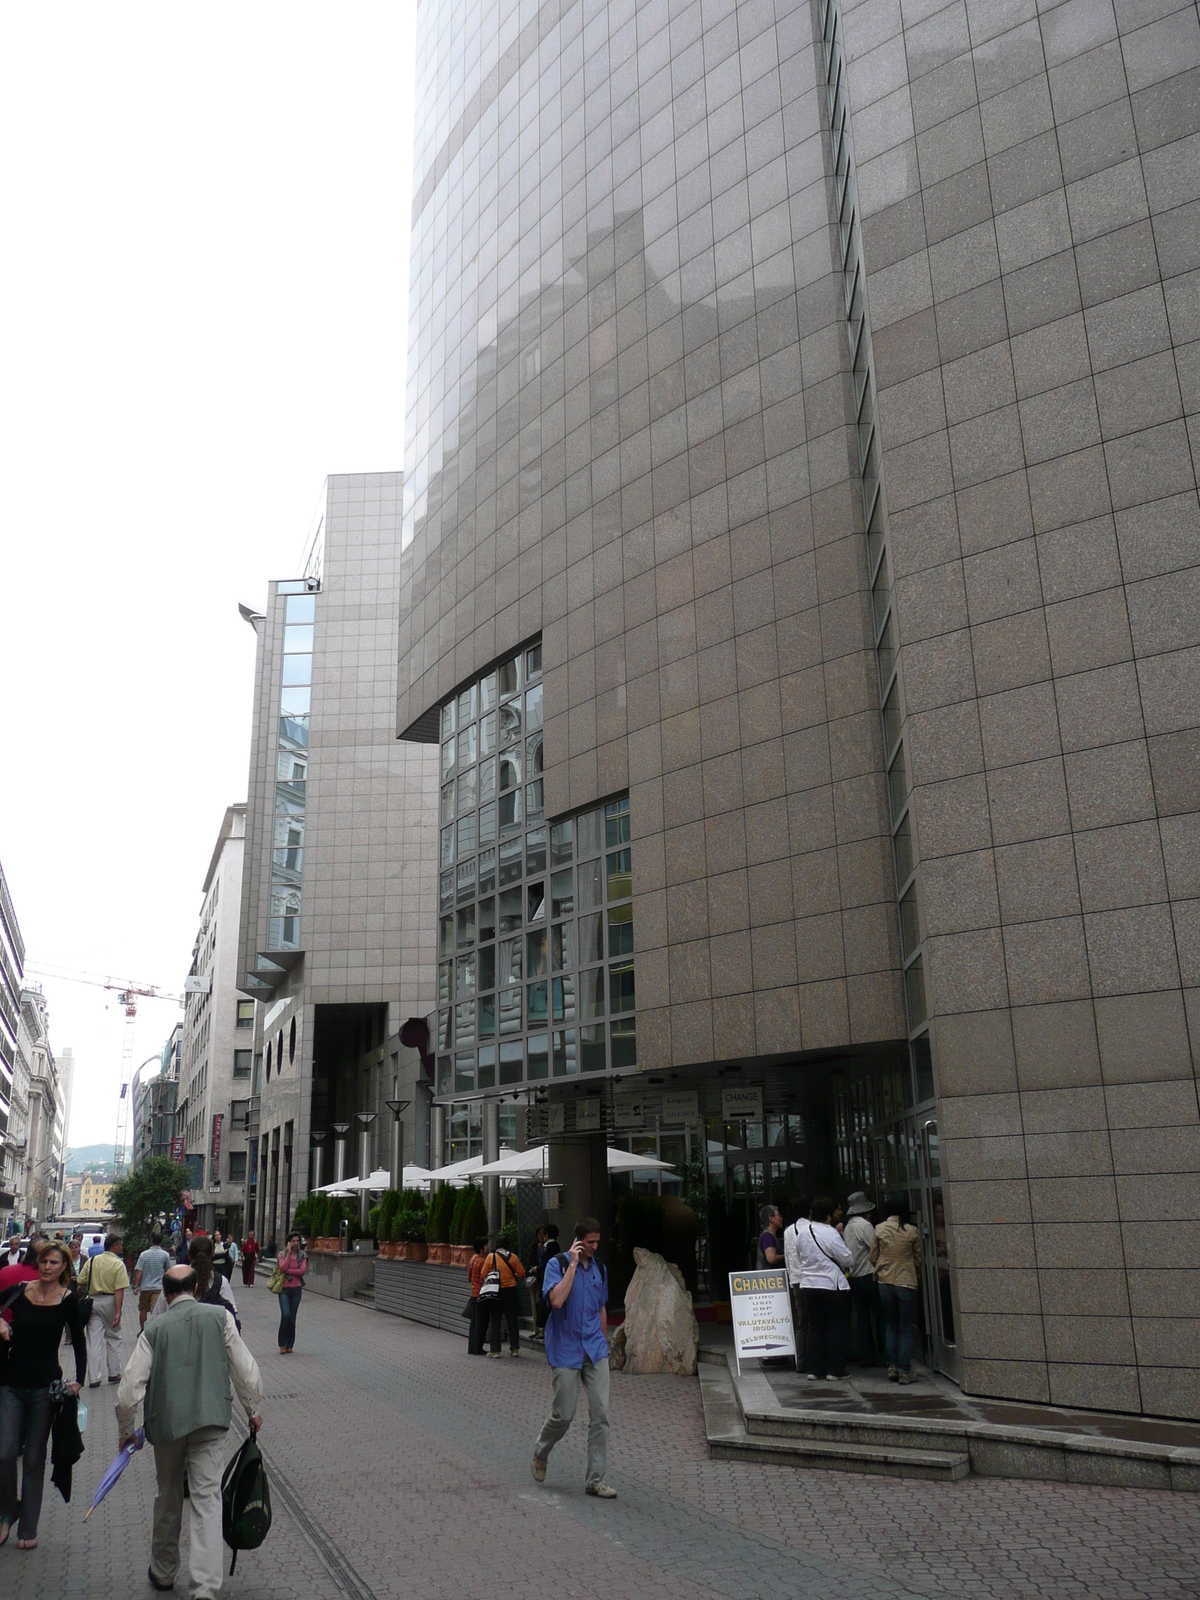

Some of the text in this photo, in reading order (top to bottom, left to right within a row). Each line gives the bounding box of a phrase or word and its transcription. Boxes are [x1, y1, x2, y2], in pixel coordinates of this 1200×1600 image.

[725, 1092, 759, 1103] CHANGE
[733, 1277, 784, 1292] CHANGE
[740, 1334, 790, 1345] GELDWECHSEL
